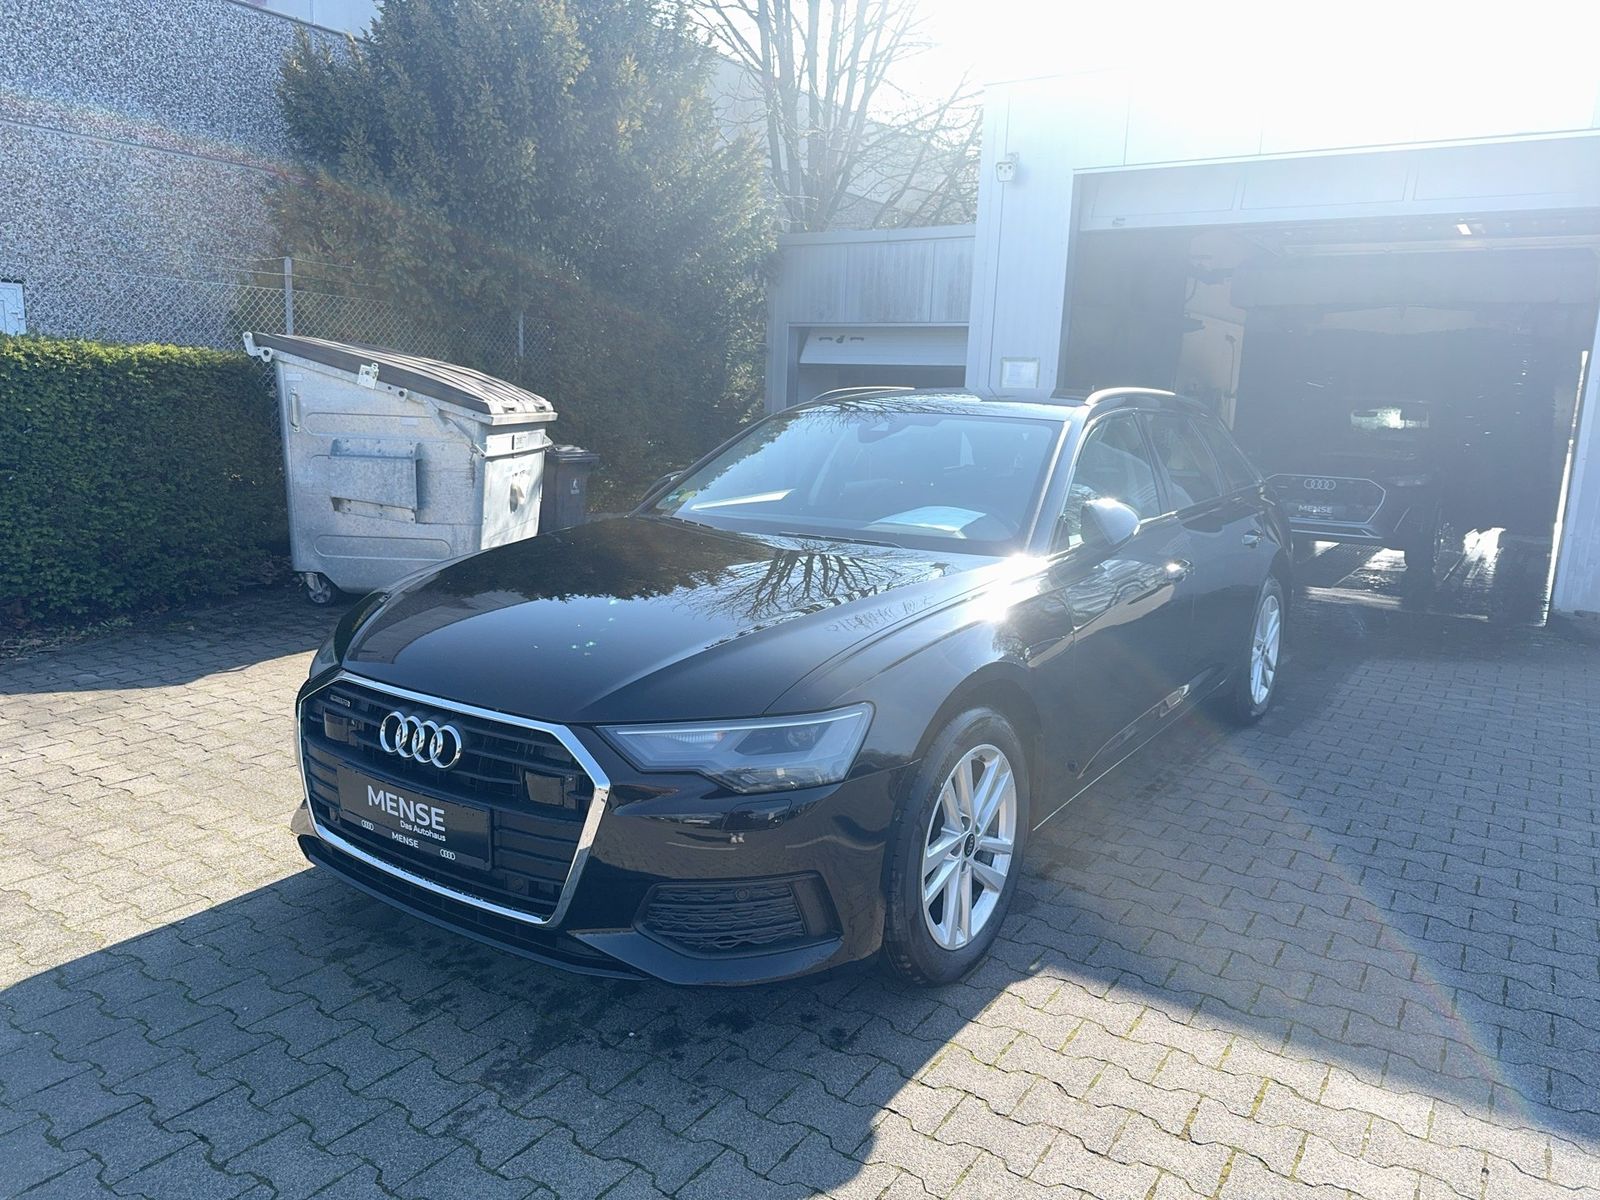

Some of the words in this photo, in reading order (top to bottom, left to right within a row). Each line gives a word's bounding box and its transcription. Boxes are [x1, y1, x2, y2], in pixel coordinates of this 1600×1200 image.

[1298, 504, 1333, 513] MENSE
[367, 785, 446, 832] MENSE
[391, 831, 419, 849] MENSE
[400, 820, 412, 831] Das
[413, 825, 446, 842] Autohaus
